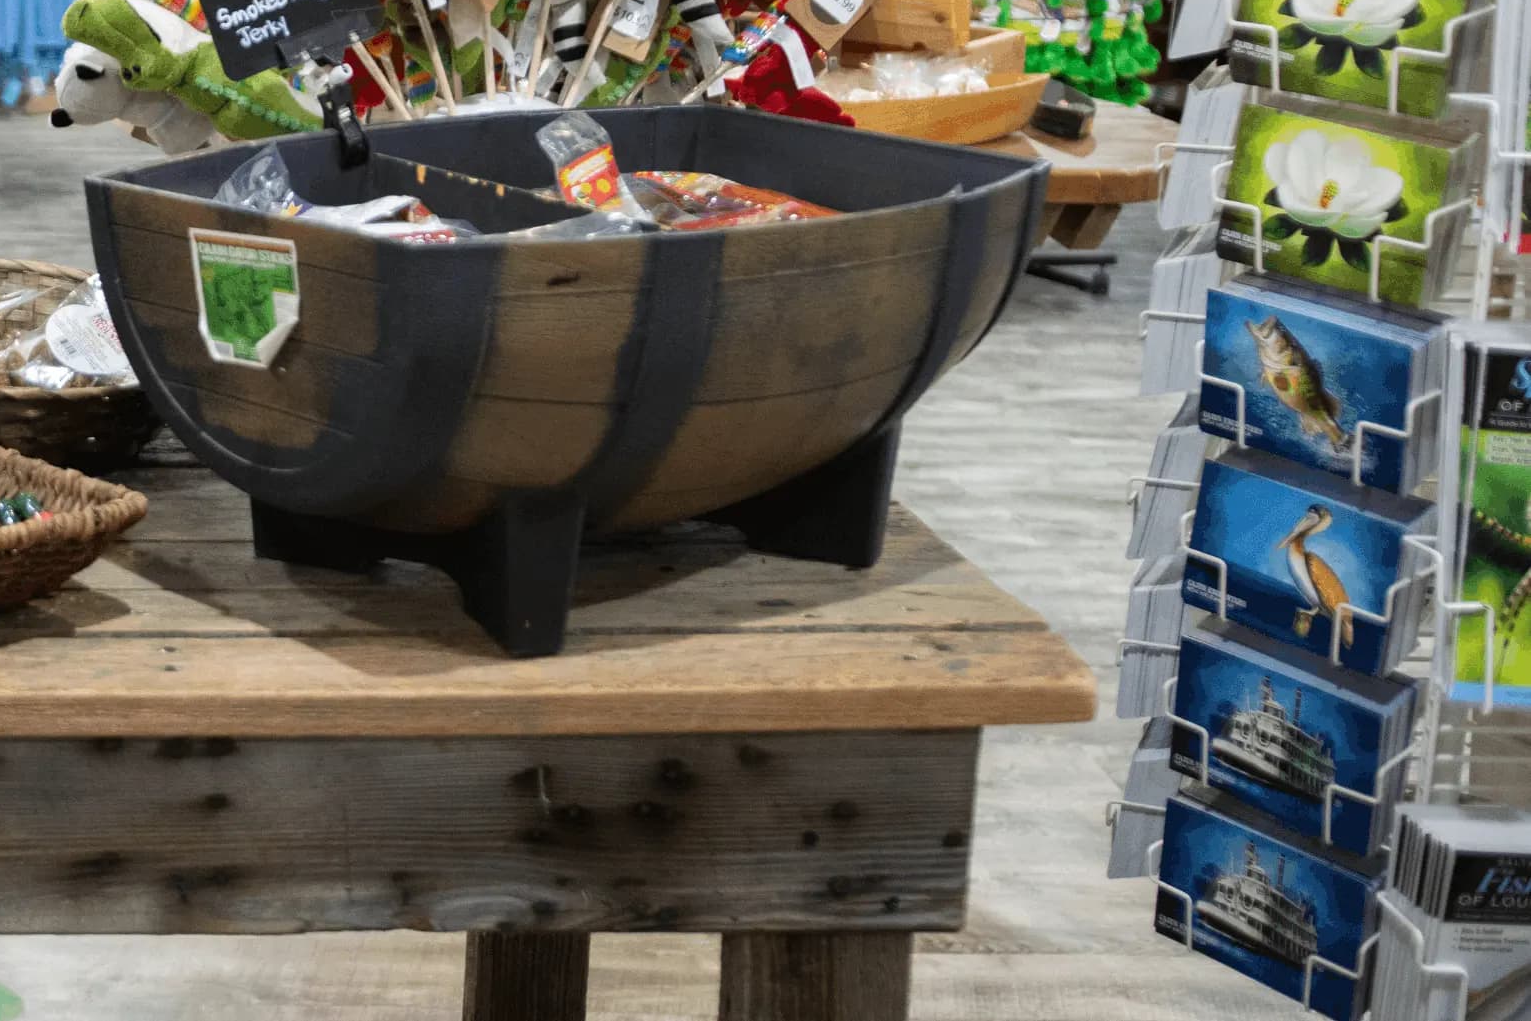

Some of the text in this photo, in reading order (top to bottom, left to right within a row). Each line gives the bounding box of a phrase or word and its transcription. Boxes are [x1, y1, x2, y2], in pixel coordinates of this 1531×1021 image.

[236, 15, 291, 49] Jerky
[1500, 401, 1524, 412] OF
[1458, 893, 1486, 908] OF
